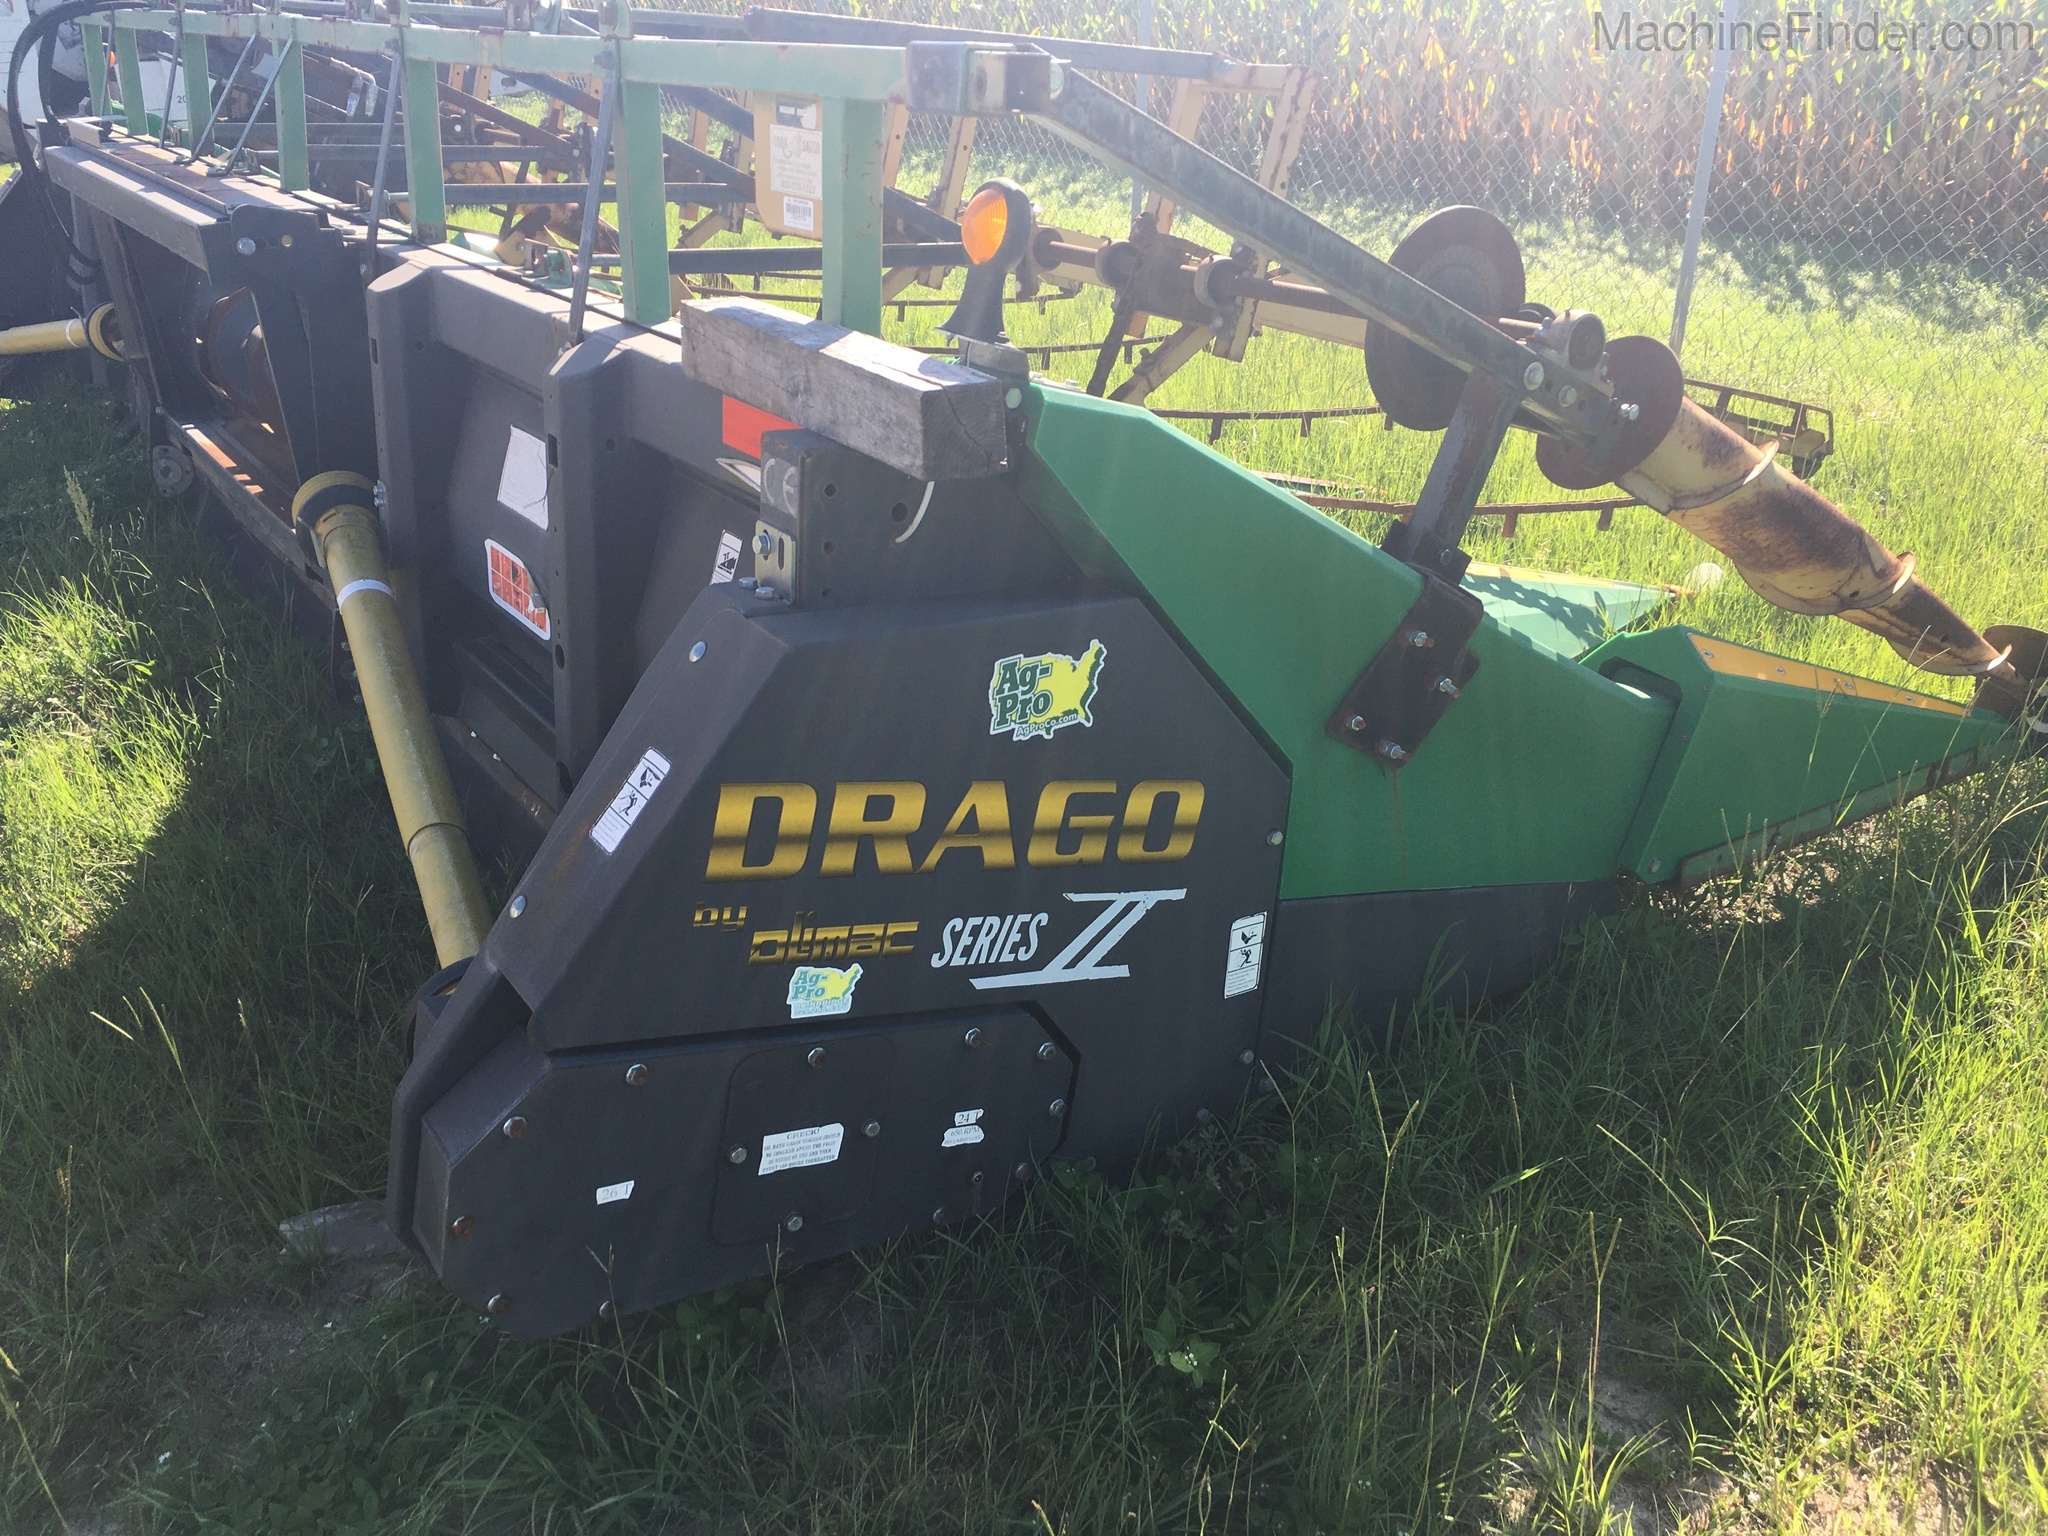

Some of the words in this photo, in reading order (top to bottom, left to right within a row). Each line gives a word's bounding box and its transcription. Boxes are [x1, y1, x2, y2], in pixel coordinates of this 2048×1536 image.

[995, 659, 1052, 698] Ag-
[995, 690, 1053, 729] Pro
[1017, 713, 1078, 737] AgProCo.com
[704, 779, 1206, 883] DRAGO
[692, 901, 748, 932] by
[931, 912, 1049, 968] SERIES
[794, 970, 828, 987] Ag-
[792, 985, 826, 1000] Pro
[957, 1113, 969, 1124] 24
[787, 1129, 820, 1139] CHECK!
[601, 1186, 618, 1200] 26
[623, 1182, 633, 1195] T
